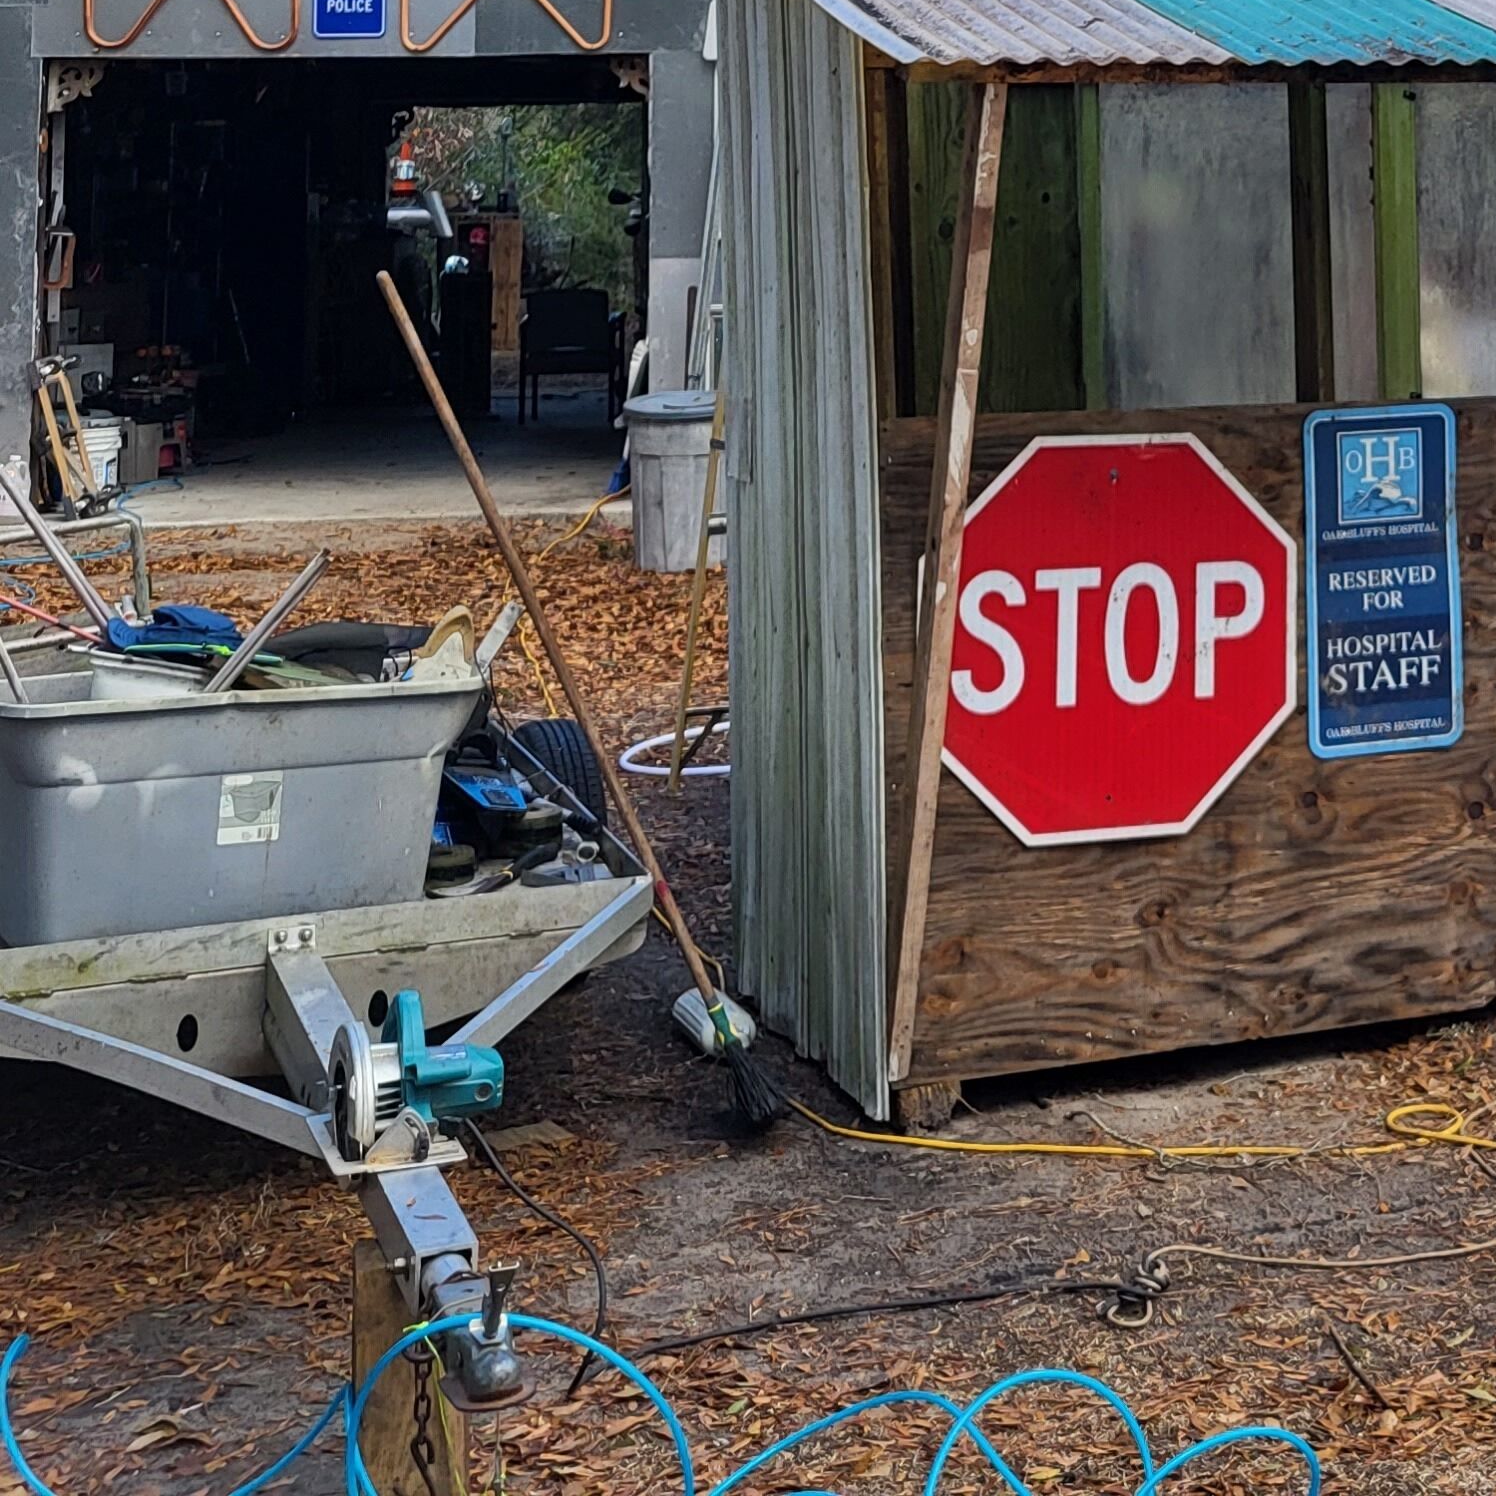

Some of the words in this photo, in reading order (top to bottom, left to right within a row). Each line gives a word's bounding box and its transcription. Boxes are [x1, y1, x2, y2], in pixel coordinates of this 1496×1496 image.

[326, 0, 373, 14] POLICE
[1388, 522, 1439, 536] HOSPITAL
[1328, 564, 1437, 592] RESERVED
[1362, 590, 1404, 612] FOR
[950, 560, 1265, 715] STOP
[1326, 629, 1442, 660] HOSPITAL
[1328, 654, 1442, 694] STAFF
[1394, 717, 1445, 732] HOSPITAL
